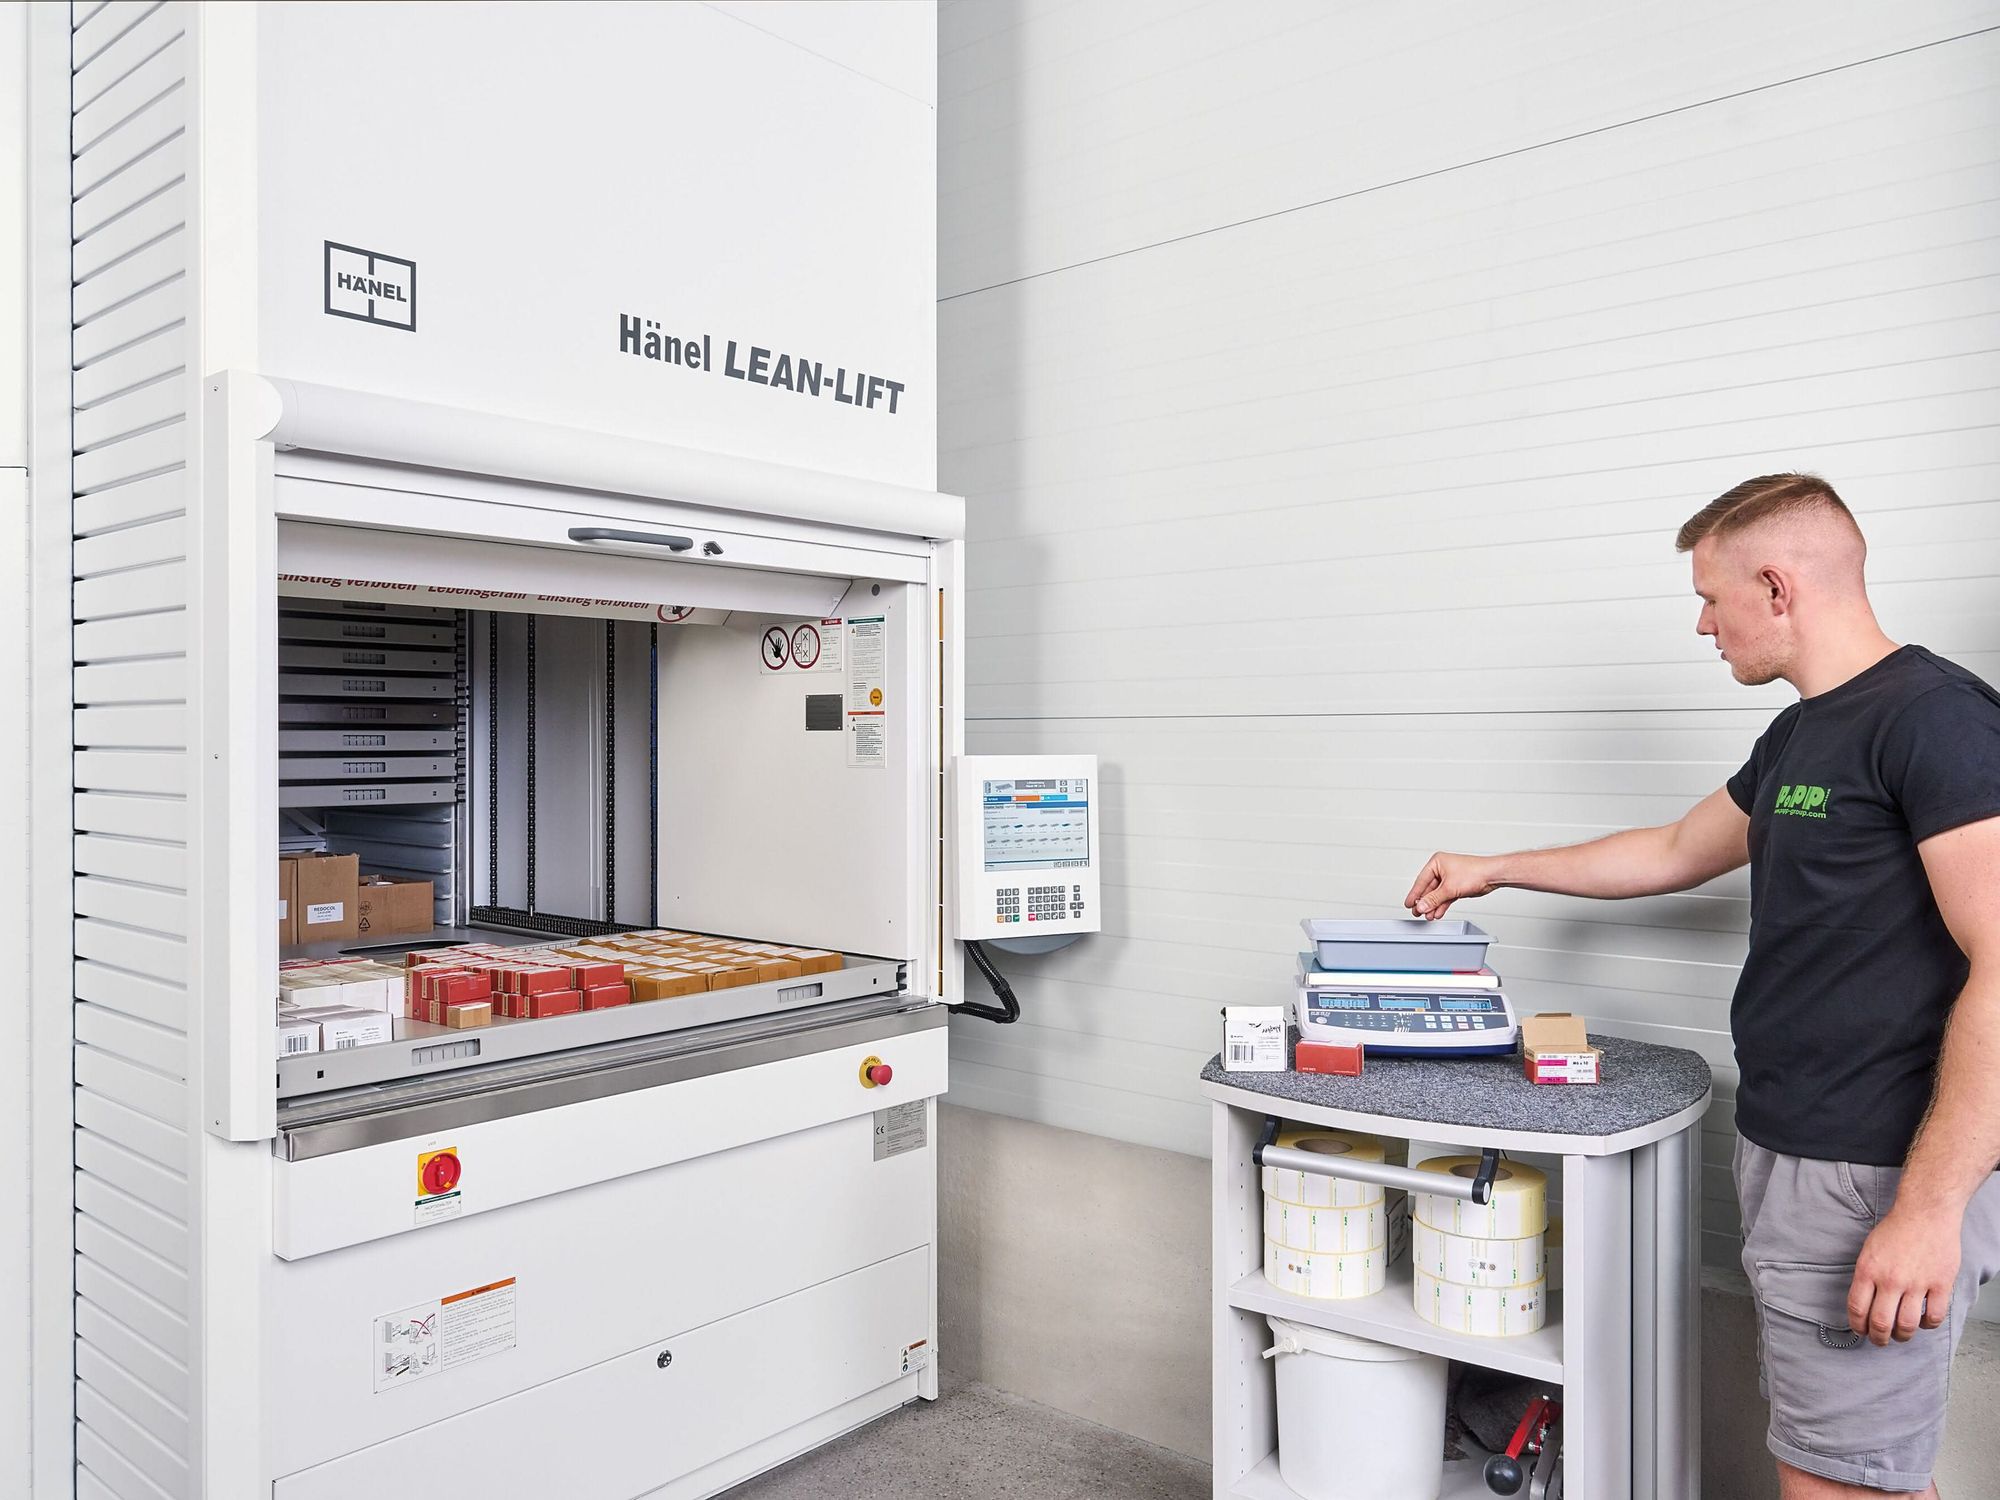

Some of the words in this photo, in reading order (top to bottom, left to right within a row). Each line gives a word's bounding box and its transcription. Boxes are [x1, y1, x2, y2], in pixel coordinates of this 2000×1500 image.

[337, 271, 407, 303] HÄNEL
[619, 313, 711, 373] Hänel
[724, 340, 905, 414] LEAN-LIFT
